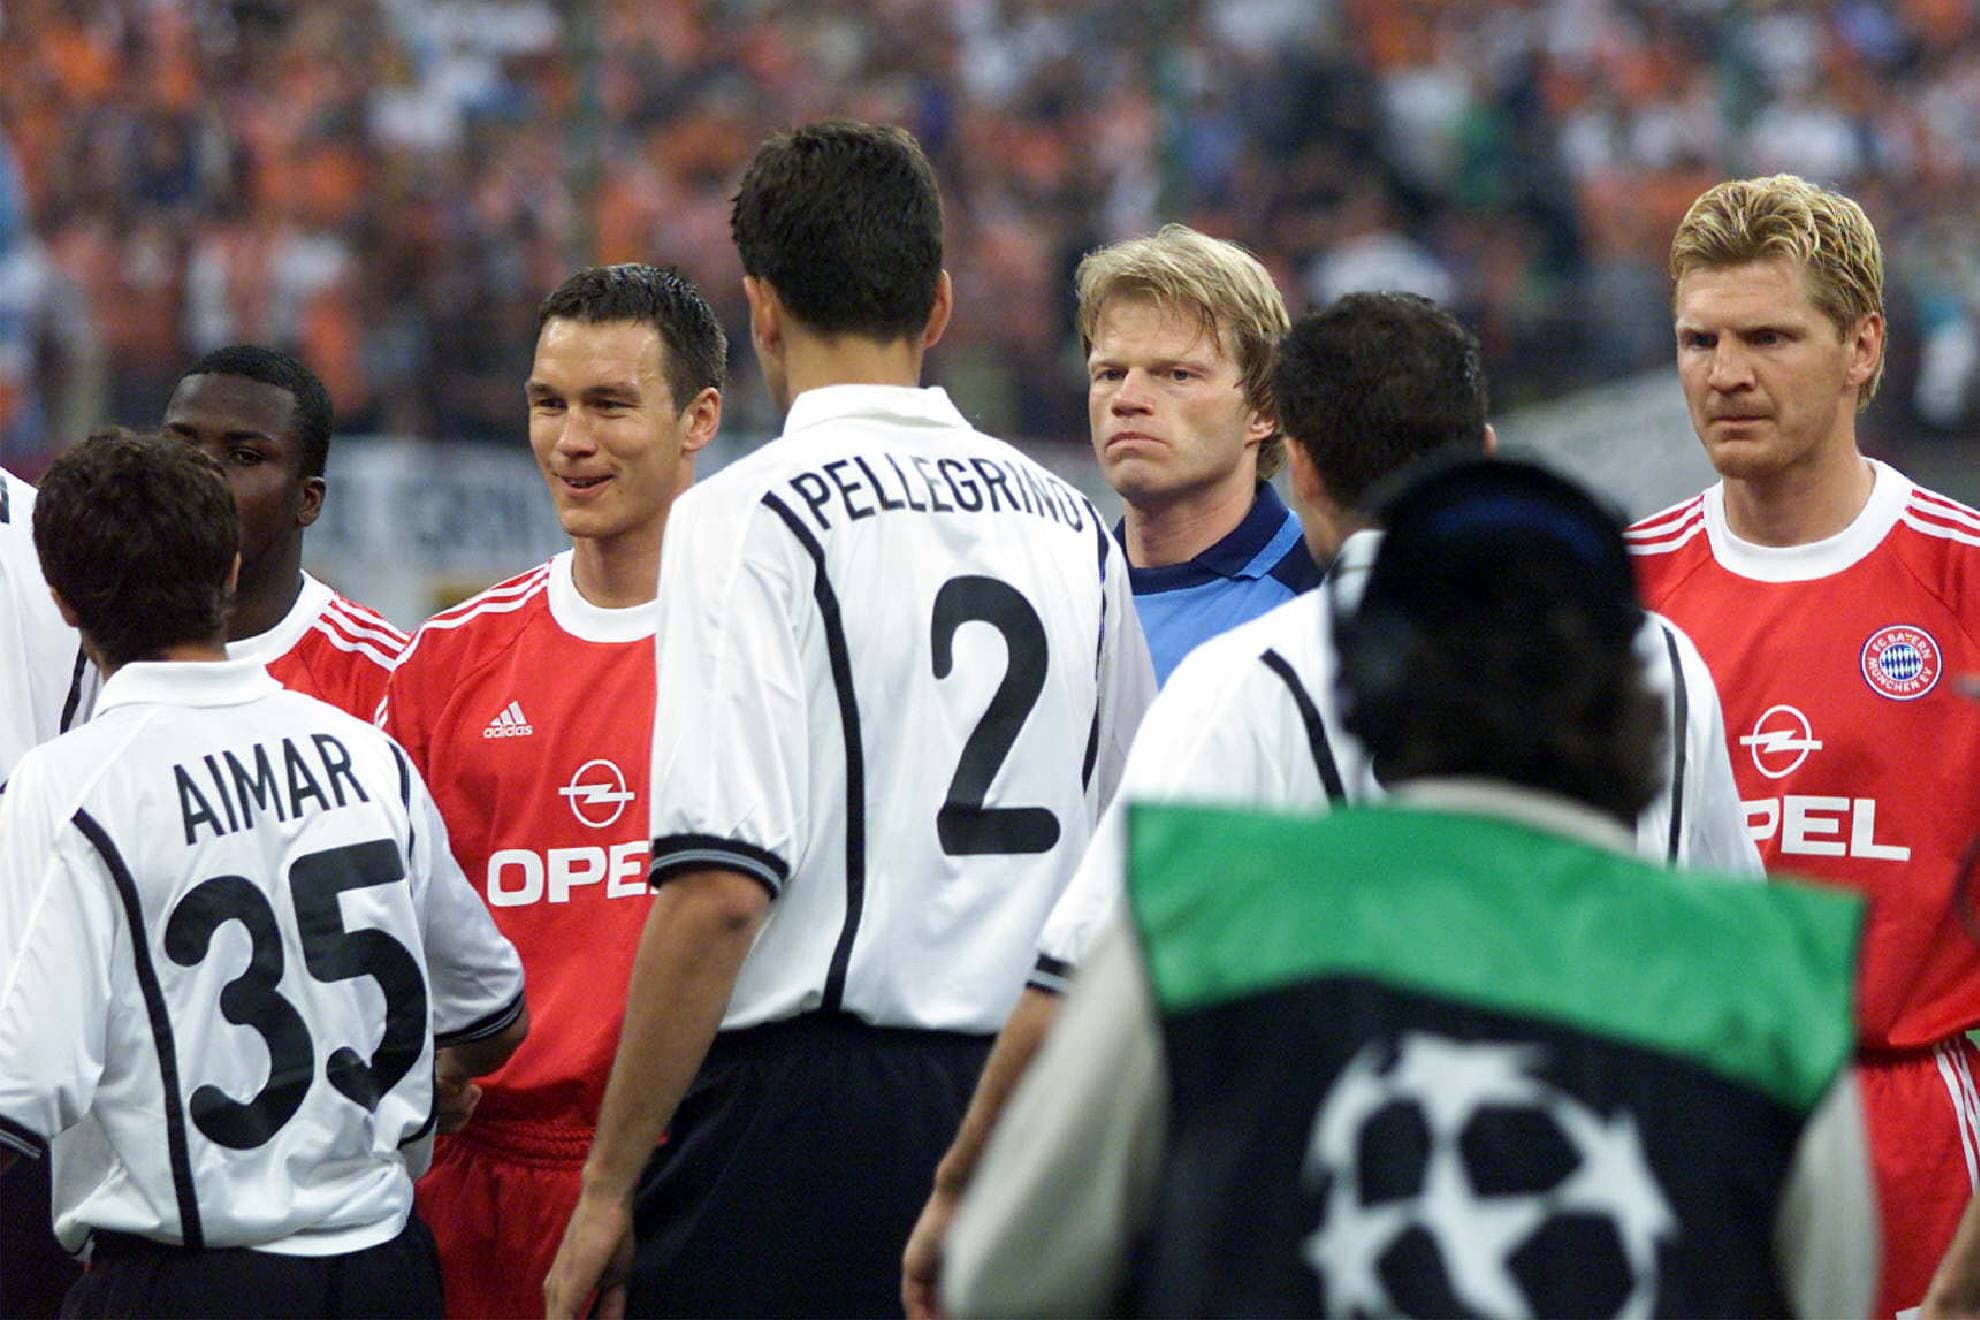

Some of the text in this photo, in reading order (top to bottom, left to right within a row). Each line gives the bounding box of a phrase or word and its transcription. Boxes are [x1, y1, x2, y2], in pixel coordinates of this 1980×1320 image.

[790, 452, 1084, 533] PELLEGRINO
[1887, 632, 1932, 659] BAYERN
[482, 724, 534, 739] adidas
[930, 574, 1061, 856] 2
[173, 733, 370, 846] AIMAR
[1740, 795, 1911, 861] PEL
[487, 841, 658, 907] OPE
[165, 838, 428, 1151] 35
